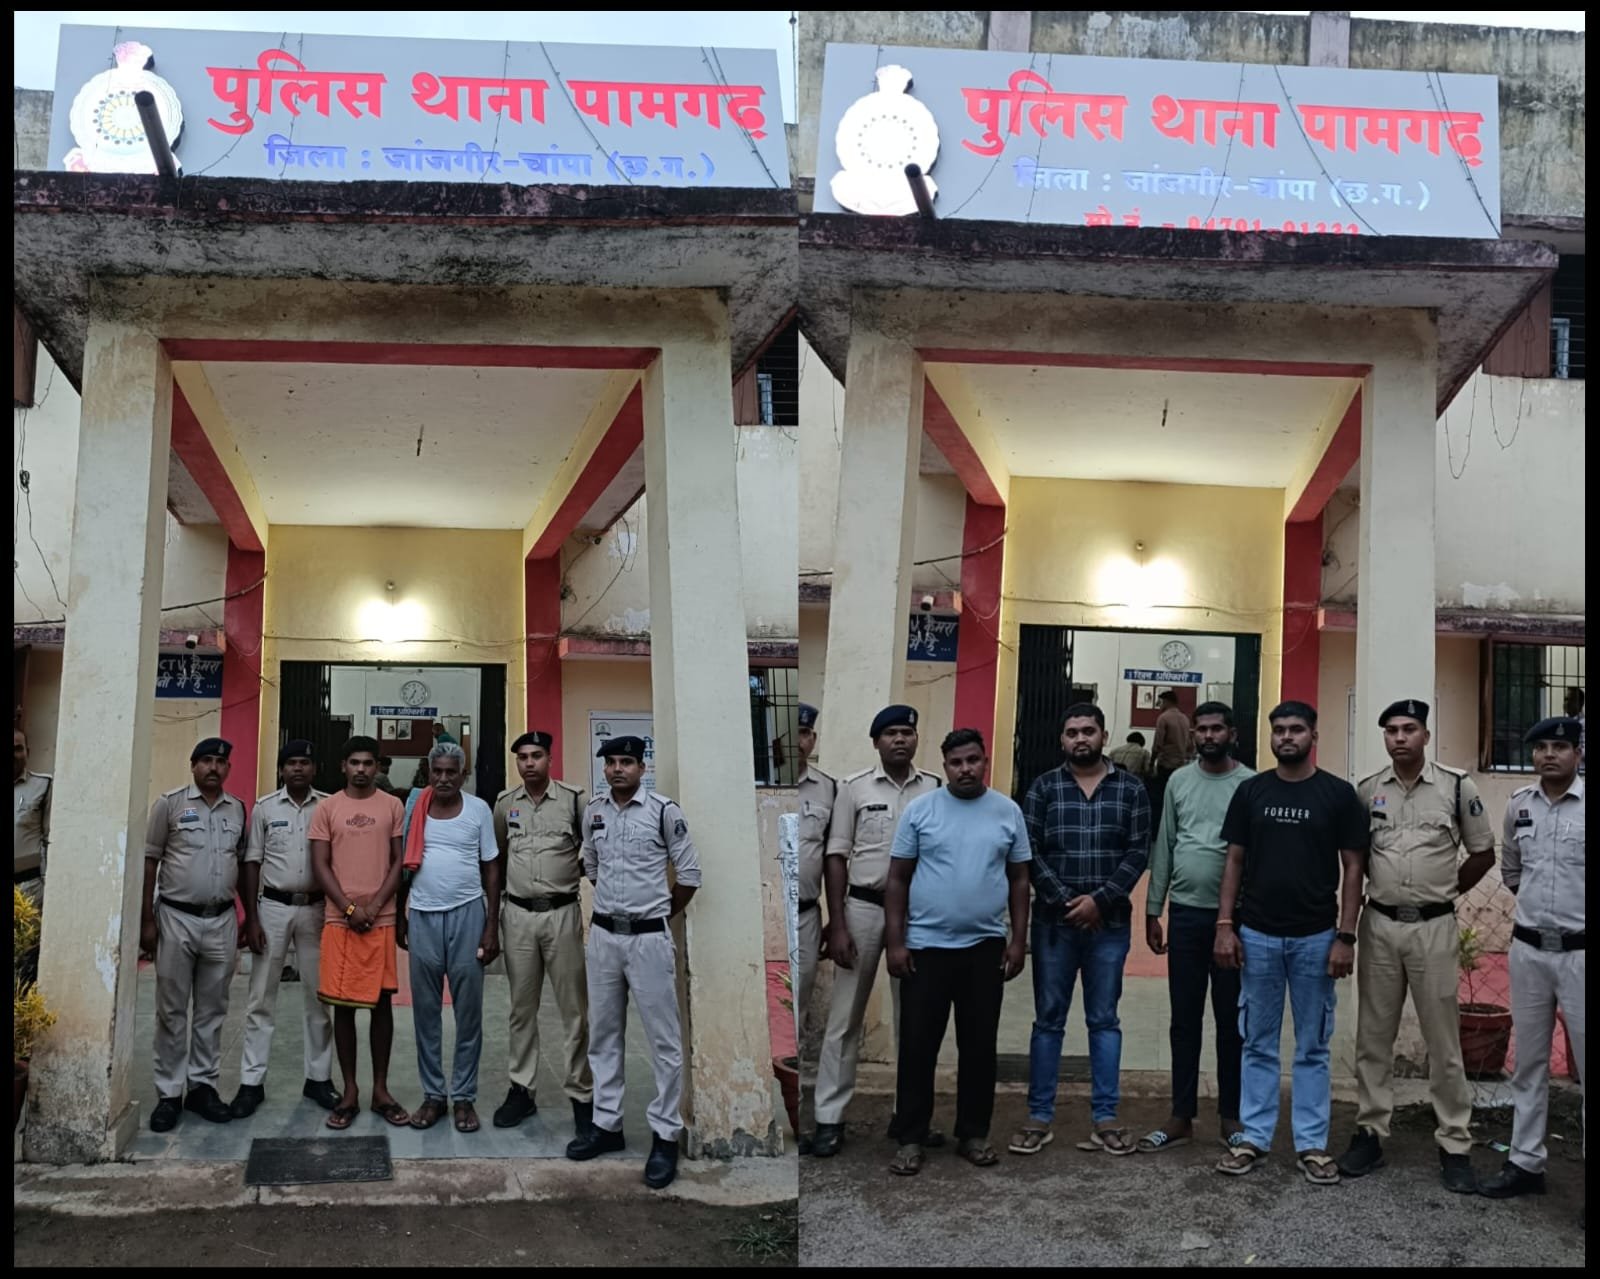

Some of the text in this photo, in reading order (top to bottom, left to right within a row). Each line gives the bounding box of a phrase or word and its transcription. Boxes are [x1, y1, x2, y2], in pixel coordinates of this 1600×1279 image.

[205, 49, 768, 140] पुलिस थाना पामगढ़
[960, 69, 1485, 167] पुलिस थाना पामगढ़
[263, 134, 347, 168] जिला
[1013, 155, 1090, 191] जिला
[1264, 806, 1311, 819] FOREVER
